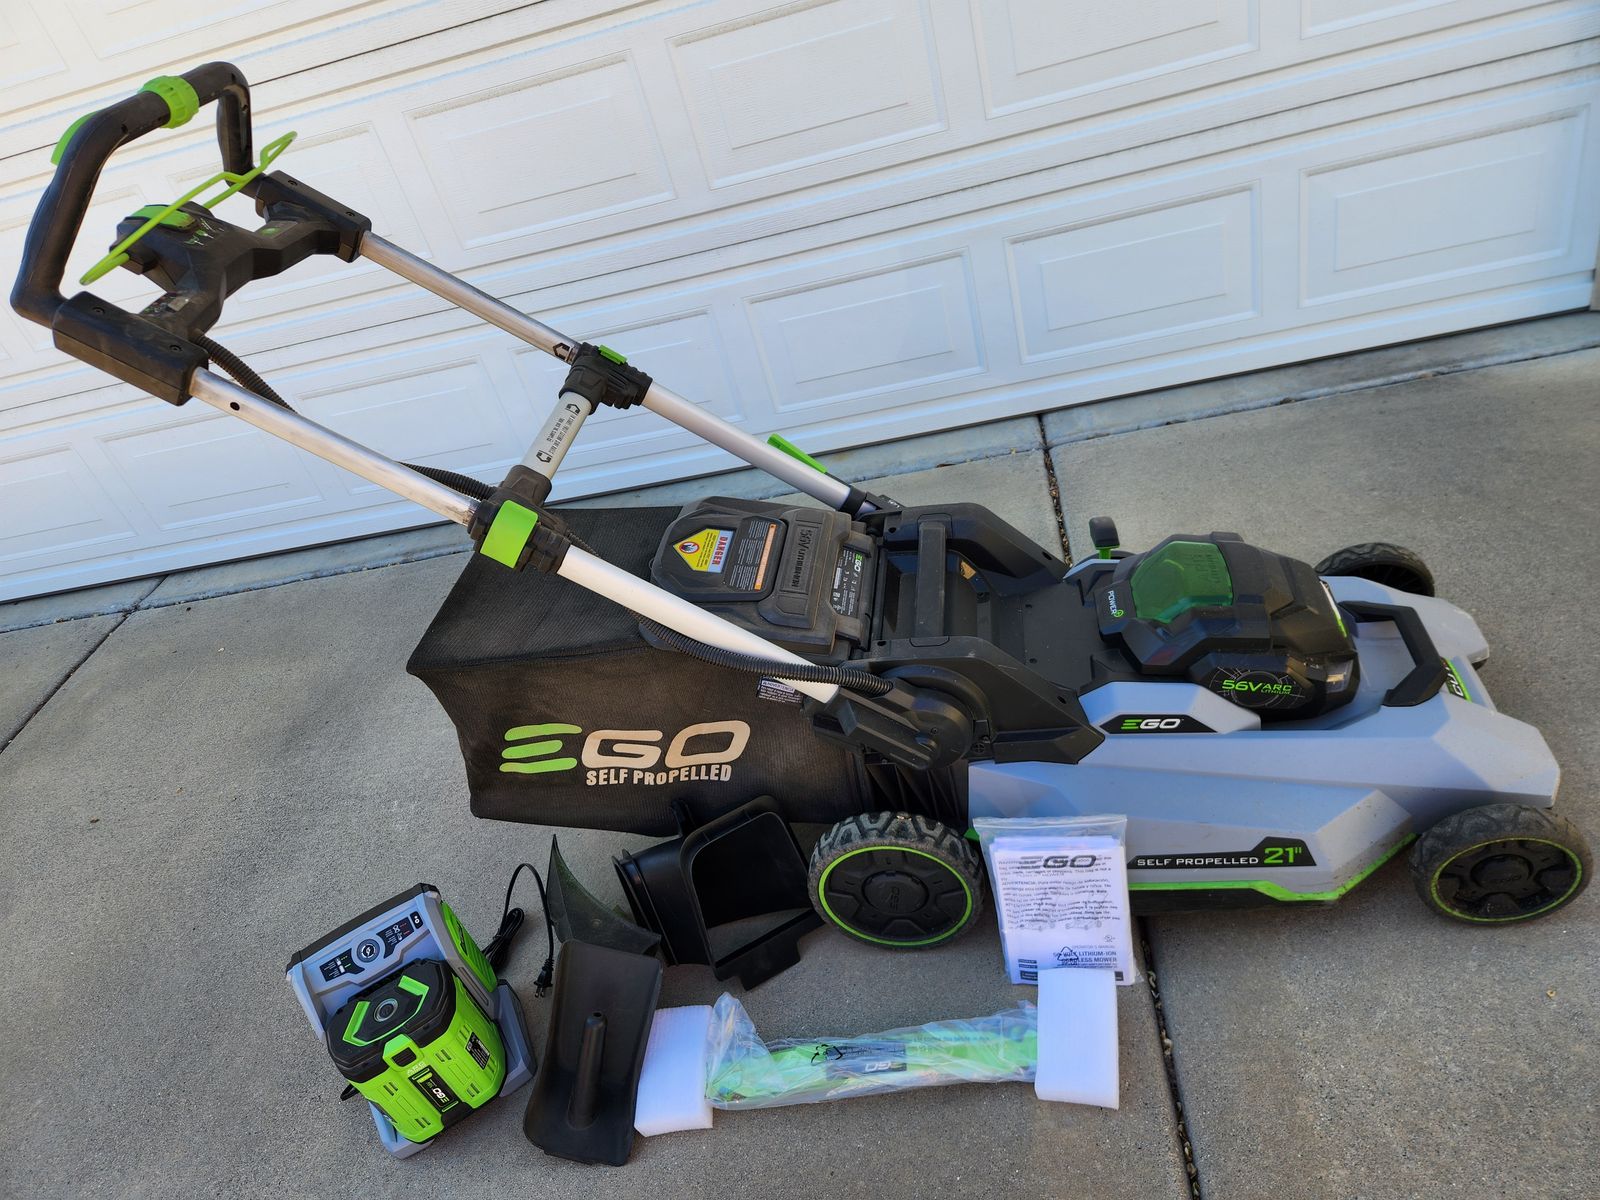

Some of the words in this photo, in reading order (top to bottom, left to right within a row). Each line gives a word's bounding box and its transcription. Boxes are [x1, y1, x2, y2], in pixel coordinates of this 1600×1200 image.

[711, 536, 728, 565] DANGER
[854, 553, 864, 573] EGO
[1107, 590, 1118, 615] POWER
[1222, 679, 1262, 692] 56V
[1262, 683, 1293, 691] ARC
[1121, 718, 1182, 730] EGO
[499, 719, 751, 774] EGO
[586, 768, 628, 786] SELF
[632, 764, 732, 785] PROPELLED
[1017, 854, 1097, 869] EGO
[1137, 858, 1172, 866] SELF
[1175, 856, 1259, 866] PROPELLED
[1263, 847, 1302, 864] 21"
[433, 1087, 450, 1104] EGO
